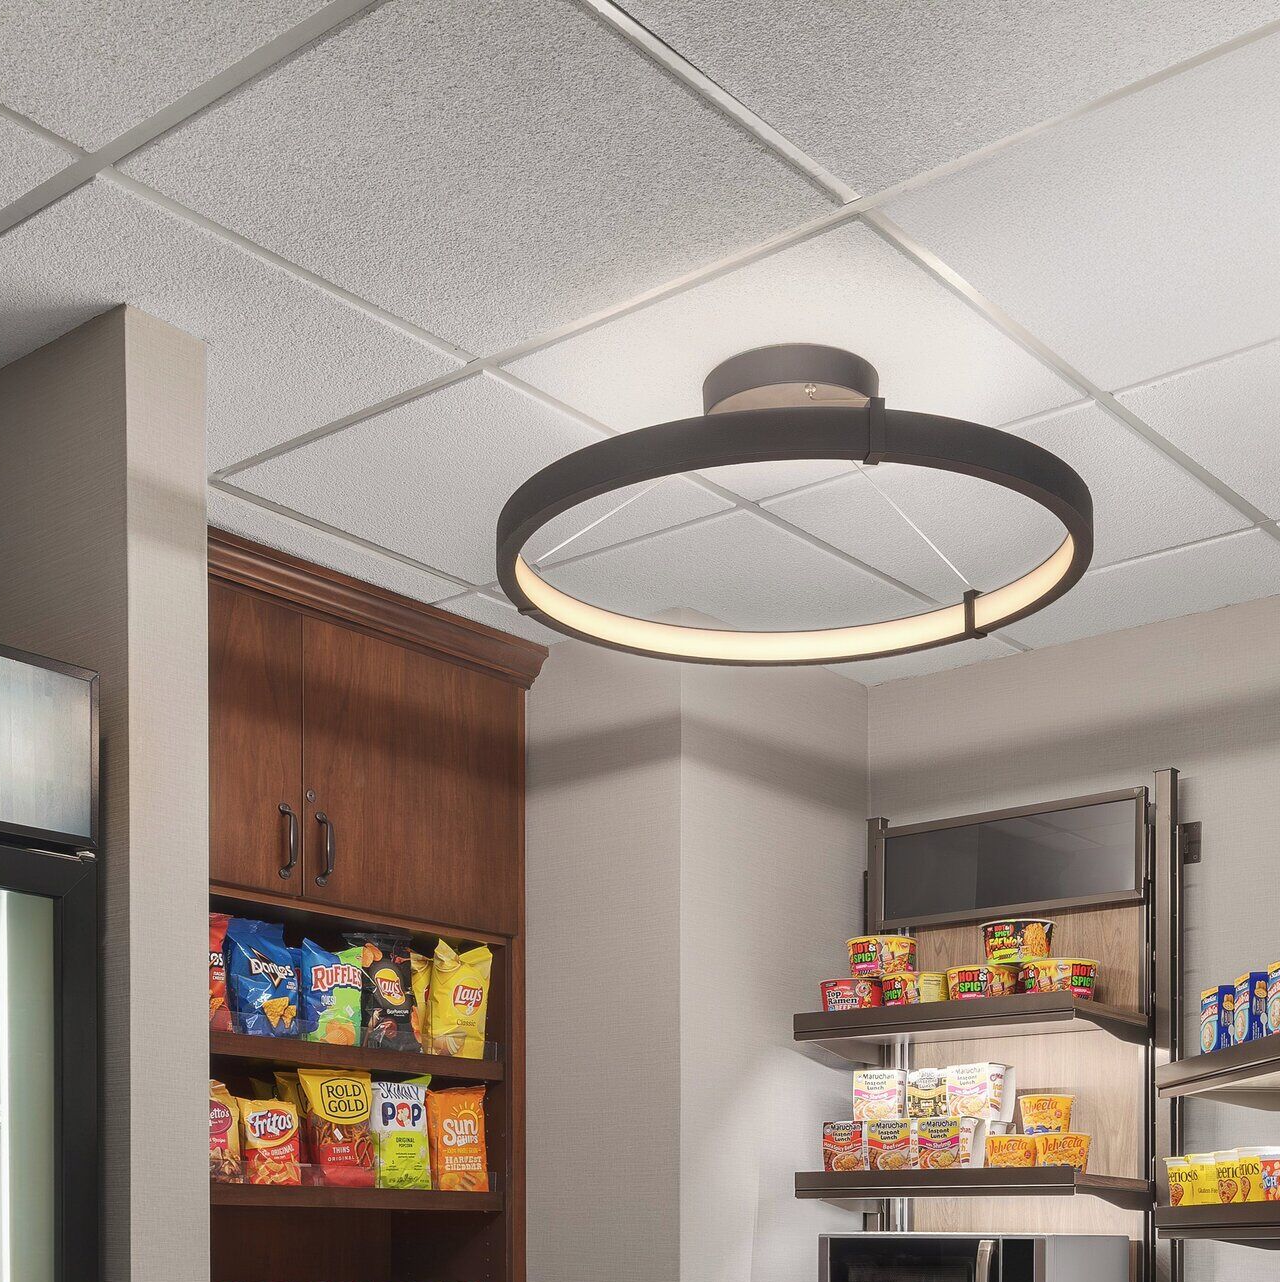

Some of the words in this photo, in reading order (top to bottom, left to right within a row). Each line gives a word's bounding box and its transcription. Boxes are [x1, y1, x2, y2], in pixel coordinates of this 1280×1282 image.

[853, 952, 877, 963] SPICY
[251, 958, 294, 981] Doritos
[312, 965, 362, 991] RUFFLES
[1072, 974, 1094, 987] SPICY
[959, 981, 986, 992] SPICY
[826, 990, 841, 999] Top
[456, 1019, 476, 1027] Classic
[863, 1072, 894, 1080] Maruchan
[327, 1085, 362, 1098] ROLD
[378, 1082, 421, 1101] SKINNY
[328, 1099, 365, 1113] GOLD
[1022, 1099, 1058, 1113] Velveeta
[382, 1102, 421, 1127] POP
[250, 1108, 293, 1137] Fritos
[876, 1122, 907, 1130] Maruchan
[926, 1120, 958, 1128] Maruchan
[332, 1146, 351, 1154] THINS
[990, 1139, 1028, 1156] Velveeta
[1042, 1136, 1084, 1152] Velveeta
[445, 1156, 482, 1164] HARVEST
[445, 1163, 482, 1171] CHEDDAR
